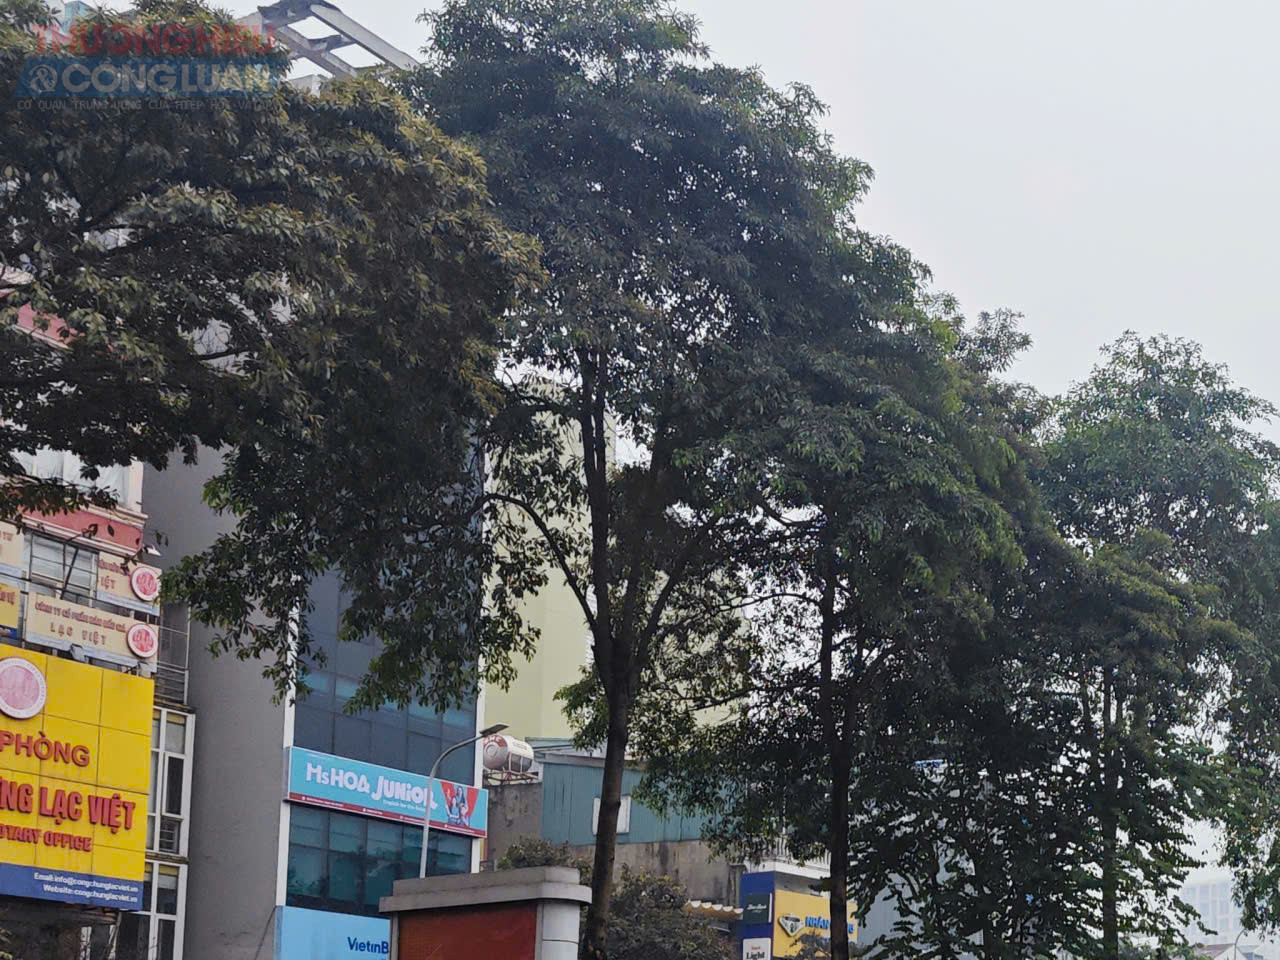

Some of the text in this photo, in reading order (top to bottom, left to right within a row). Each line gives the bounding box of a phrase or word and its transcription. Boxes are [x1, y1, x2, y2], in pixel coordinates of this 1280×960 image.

[50, 621, 107, 646] LẠC VIỆT
[0, 730, 90, 768] PHÒNG
[0, 776, 136, 834] NG LẠC VIỆT
[43, 830, 93, 852] OFFICE
